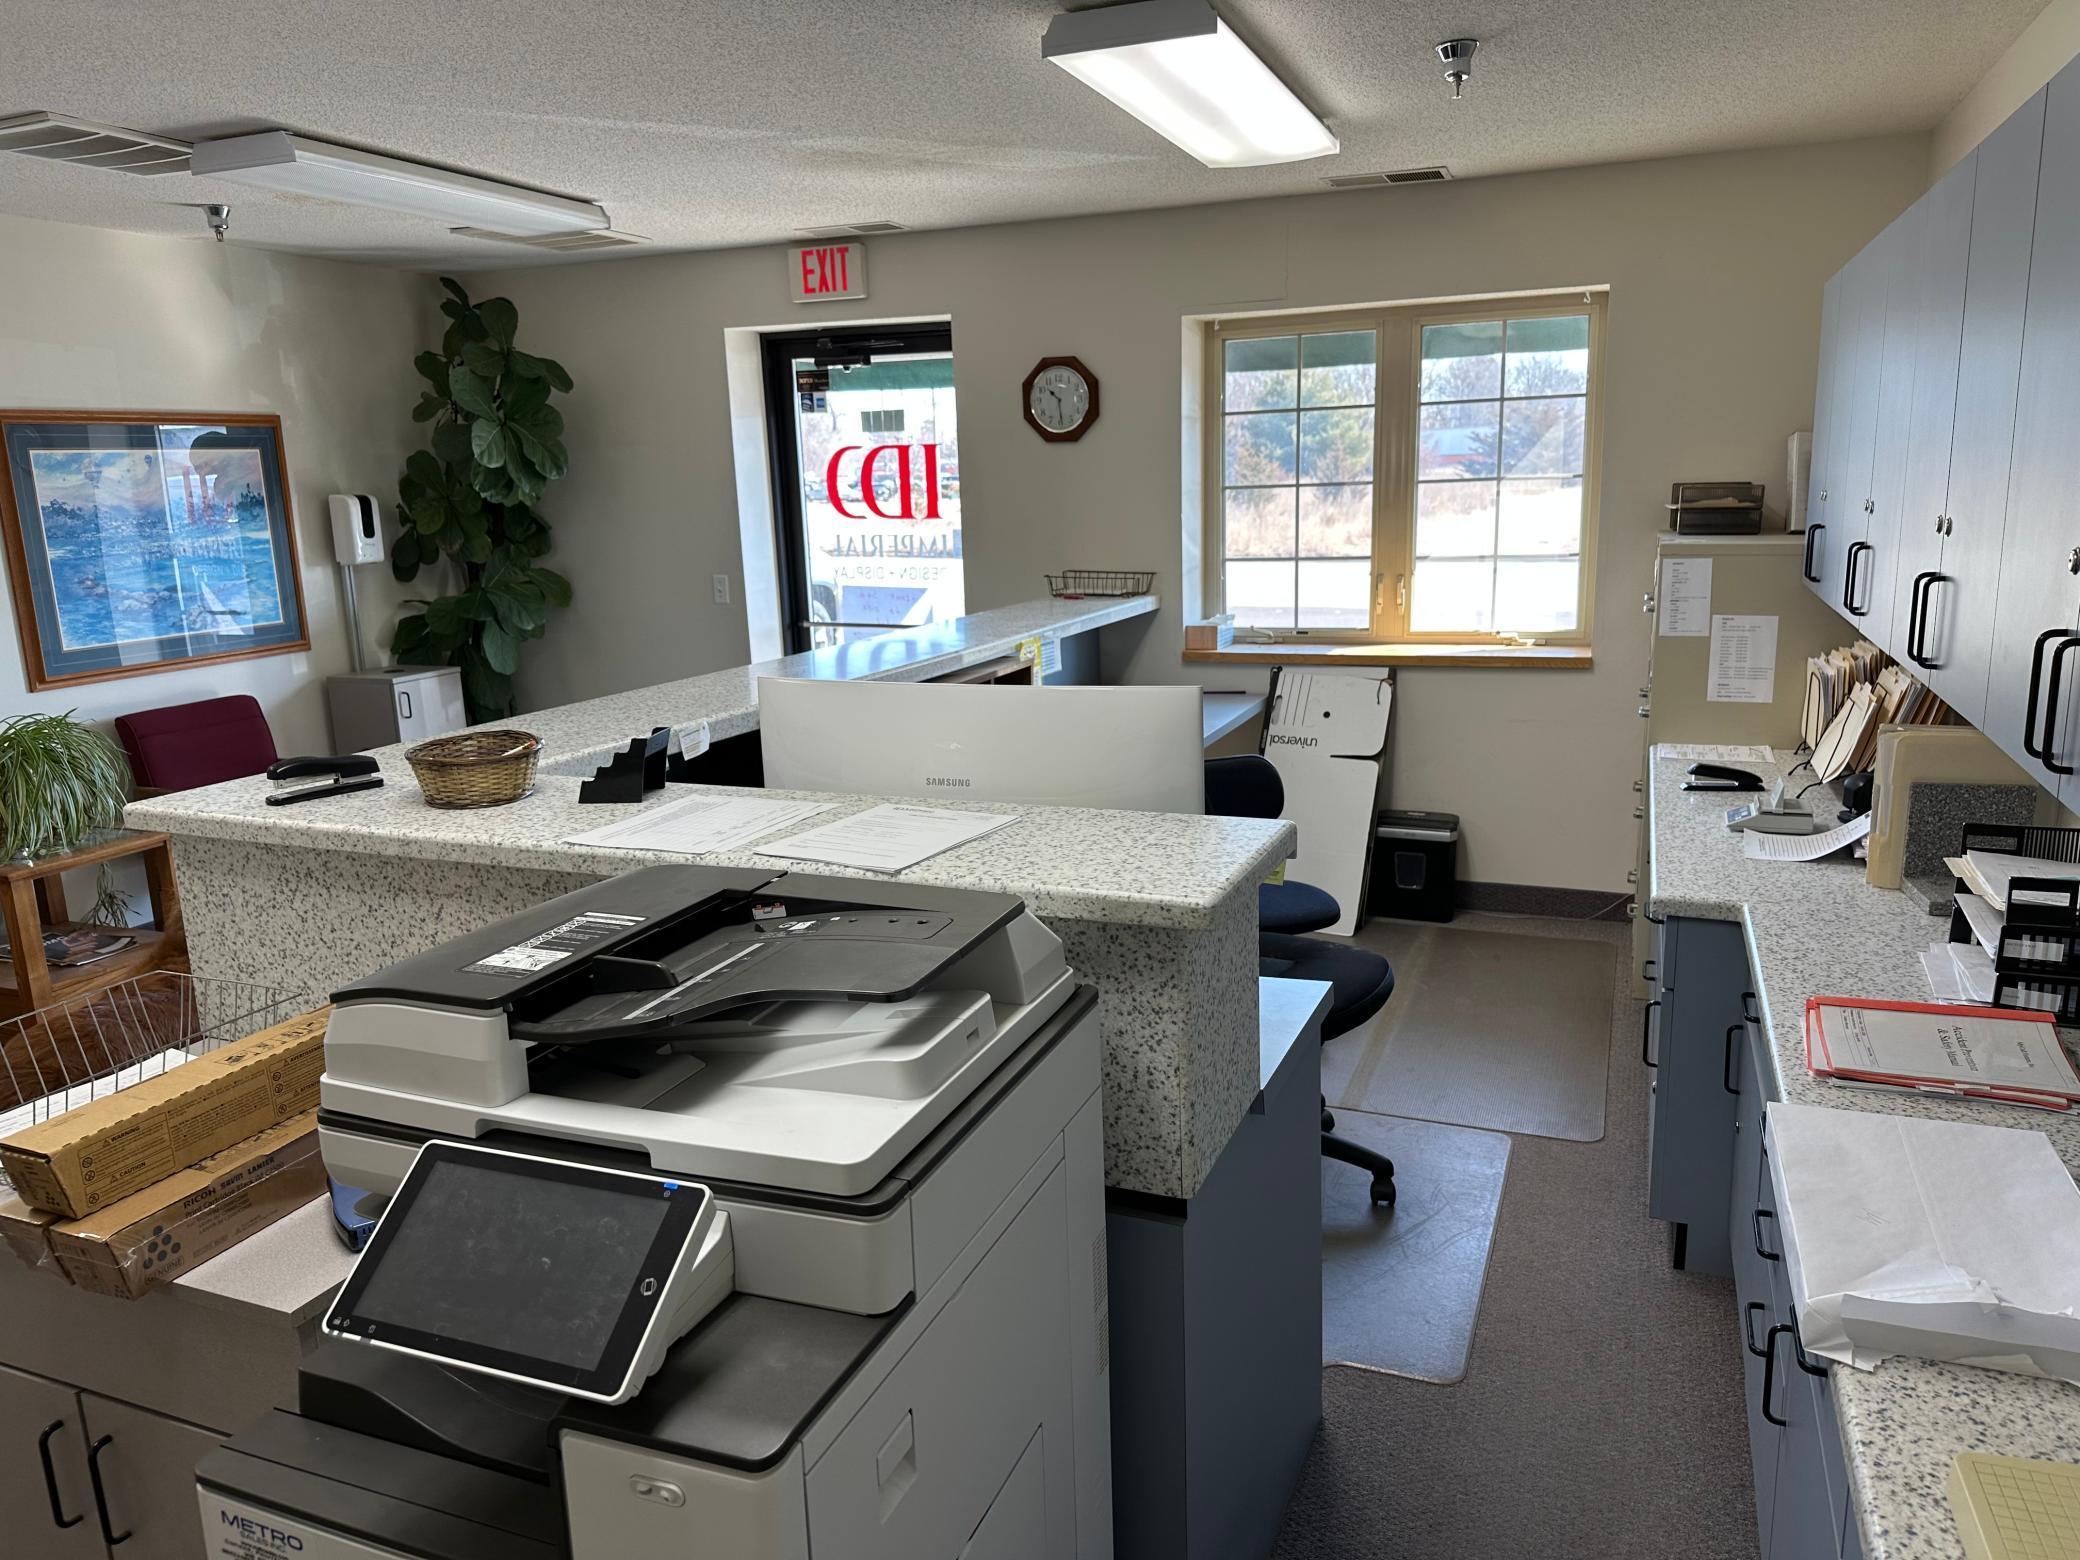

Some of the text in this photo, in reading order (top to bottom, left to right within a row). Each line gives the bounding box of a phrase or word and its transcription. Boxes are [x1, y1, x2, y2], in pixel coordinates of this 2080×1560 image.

[802, 247, 849, 294] EXIT
[1268, 734, 1318, 749] universal
[925, 777, 971, 787] SAMSUNG
[111, 1126, 140, 1142] WARNING
[120, 1162, 146, 1177] CAUTION
[184, 1186, 216, 1209] RICOH
[221, 1510, 303, 1551] METRO
